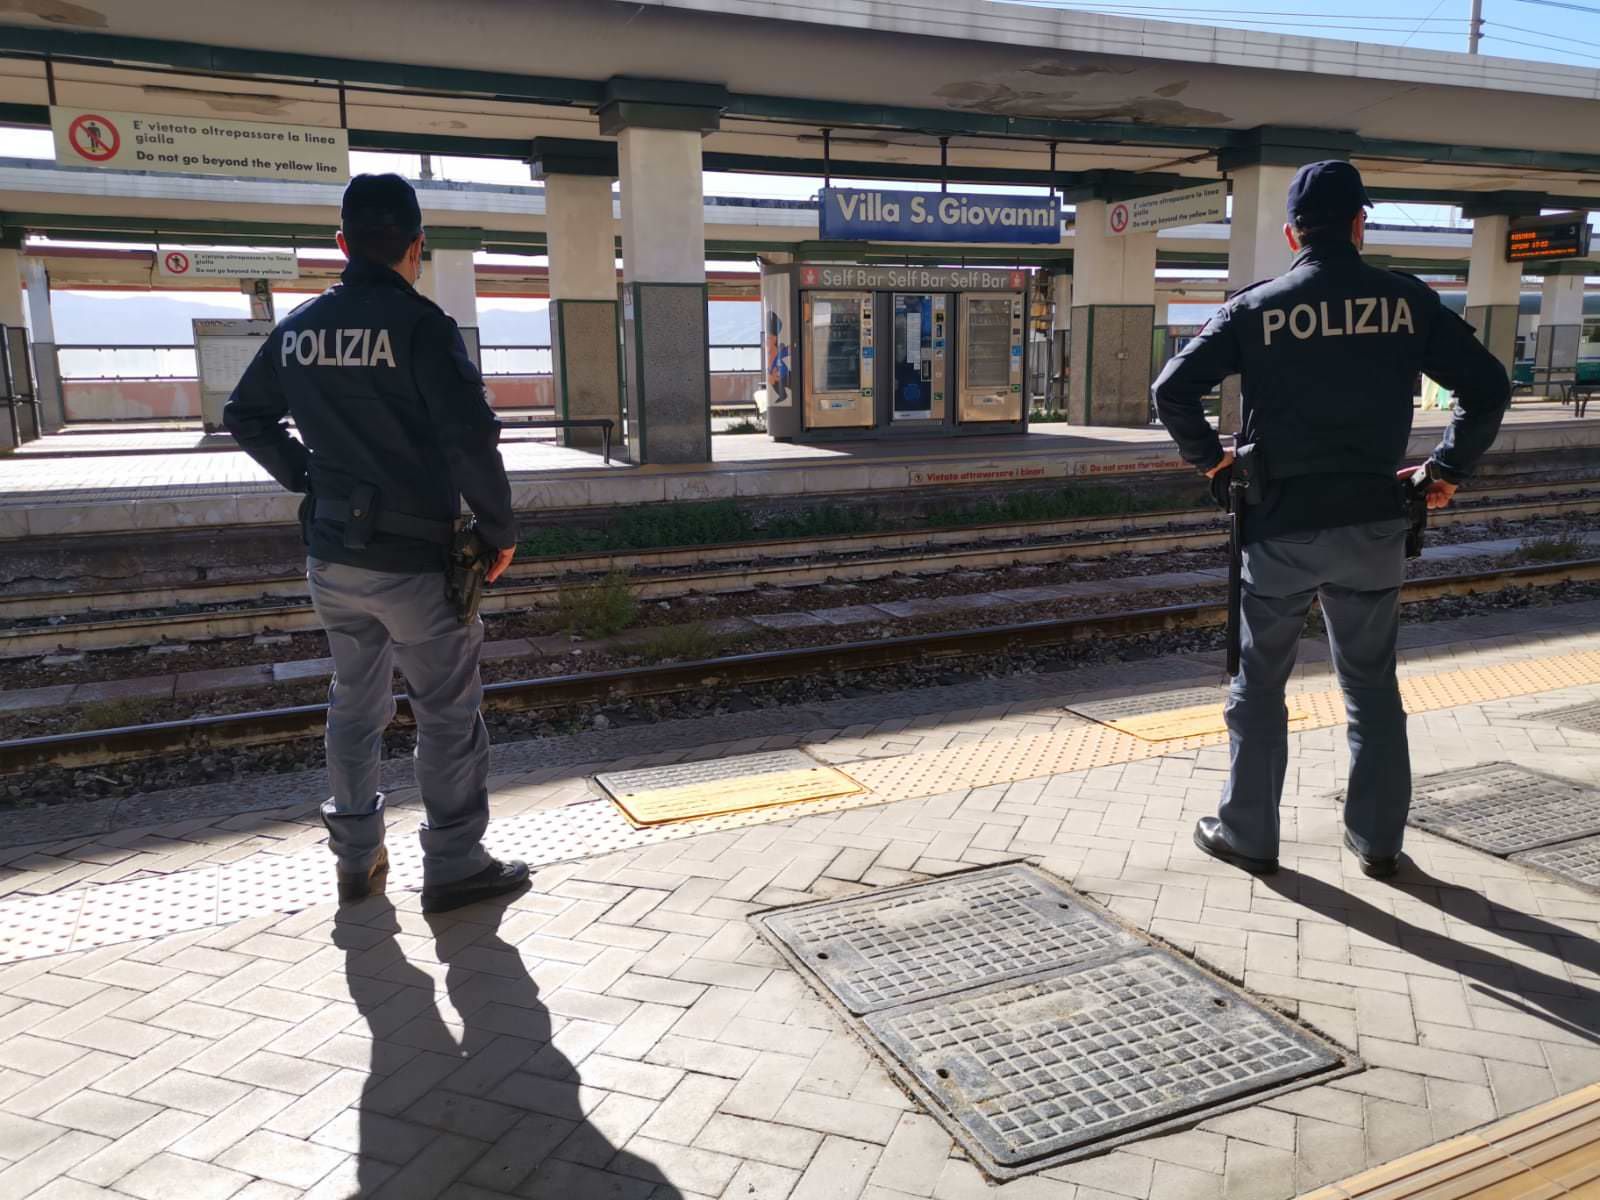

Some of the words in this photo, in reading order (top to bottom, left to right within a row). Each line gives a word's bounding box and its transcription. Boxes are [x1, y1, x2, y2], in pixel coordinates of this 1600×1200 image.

[135, 133, 175, 145] gialla
[148, 121, 197, 135] vietato
[201, 125, 285, 142] oltrepassare
[288, 131, 300, 142] la
[304, 132, 335, 145] linea
[136, 151, 154, 161] Do
[158, 152, 179, 162] not
[182, 155, 199, 166] go
[202, 155, 248, 168] beyond
[252, 159, 271, 169] the
[274, 161, 313, 174] yellow
[316, 162, 337, 173] line
[836, 192, 900, 222] Villa
[910, 196, 934, 224] S.
[938, 195, 1056, 227] Giovanni
[822, 270, 851, 287] Self
[857, 270, 883, 287] Bar
[888, 270, 916, 288] Self
[920, 271, 946, 288] Bar
[950, 271, 979, 288] Self
[981, 272, 1007, 288] Bar
[1262, 297, 1415, 346] POLIZIA
[281, 328, 397, 368] POLIZIA
[927, 472, 958, 482] Vietato
